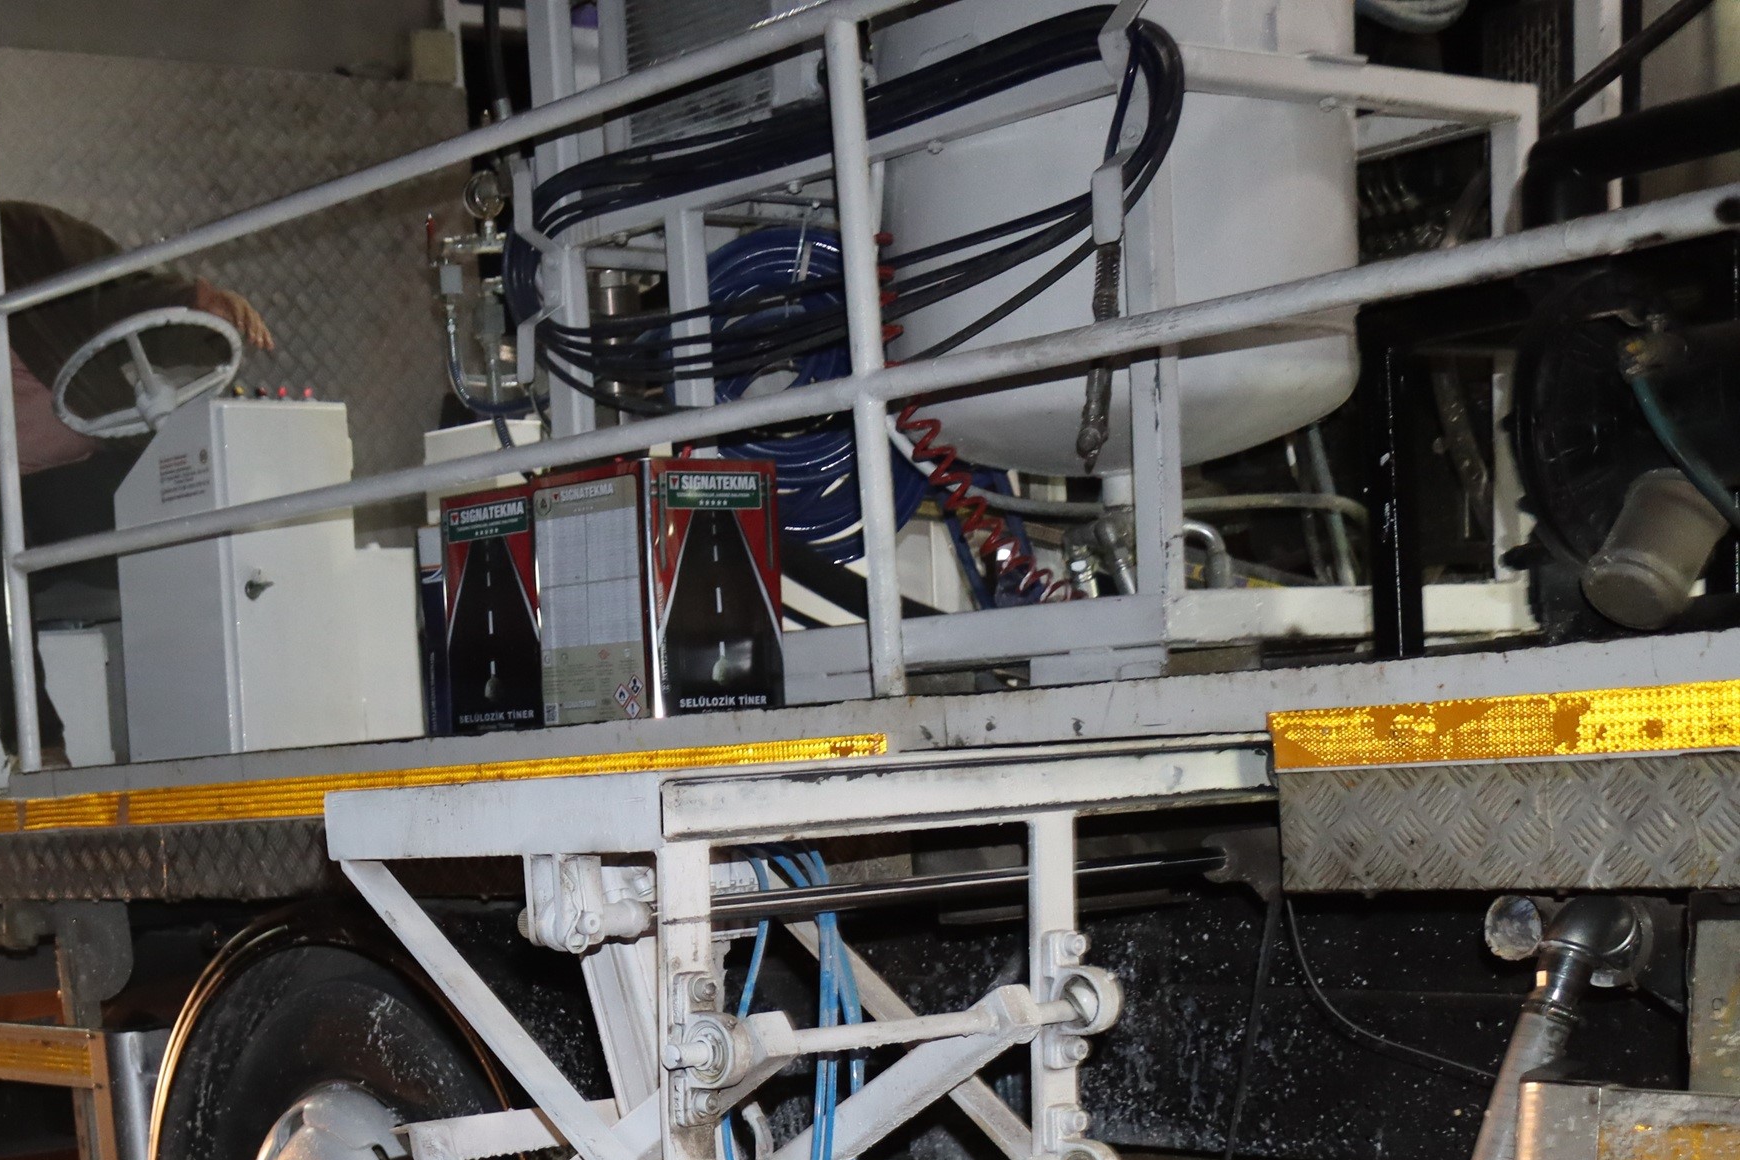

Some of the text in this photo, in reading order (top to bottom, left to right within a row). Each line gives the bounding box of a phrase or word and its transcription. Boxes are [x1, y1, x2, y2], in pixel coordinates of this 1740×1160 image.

[681, 474, 757, 491] SIGNATEKMA
[560, 482, 614, 502] SIGNATEKMA
[460, 500, 525, 524] SIGNATEKMA
[680, 693, 767, 708] SELÜLOZİK TİNER
[507, 708, 535, 720] TİNER
